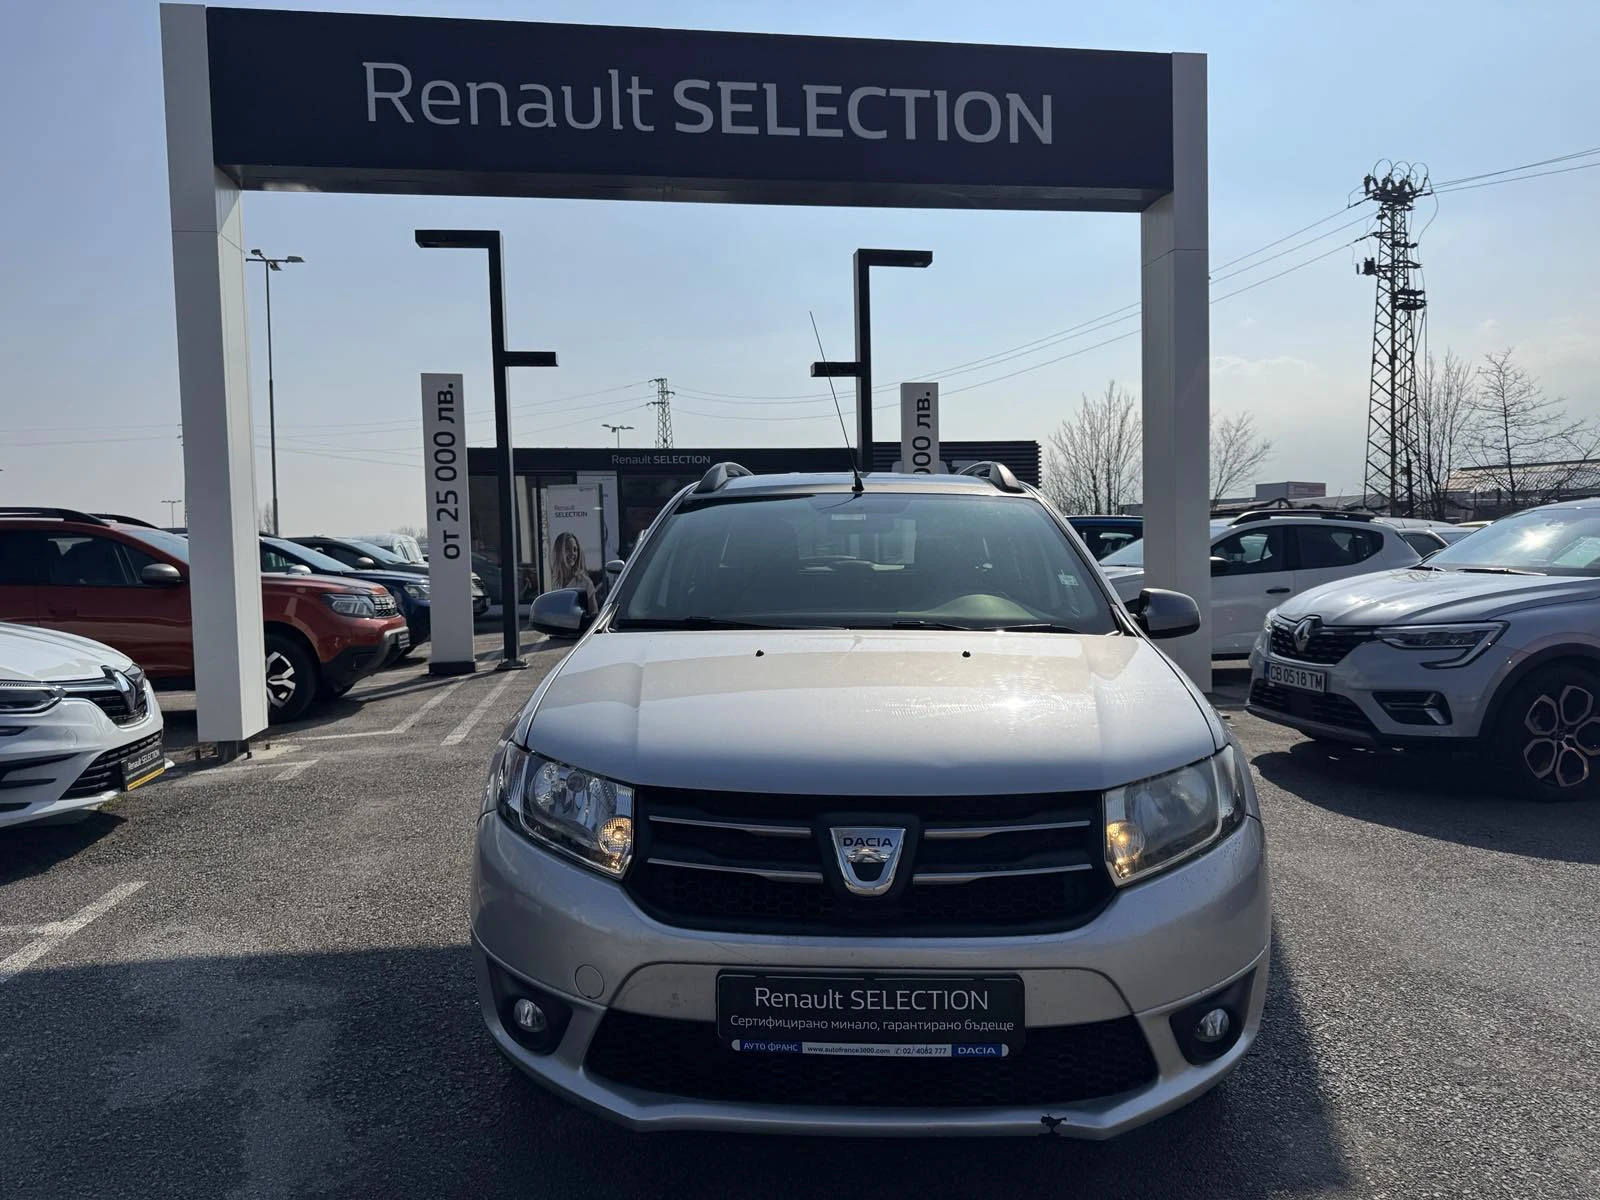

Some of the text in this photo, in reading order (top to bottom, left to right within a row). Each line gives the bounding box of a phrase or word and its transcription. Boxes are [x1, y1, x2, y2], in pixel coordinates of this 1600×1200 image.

[362, 61, 1053, 145] Renault SELECTION
[916, 391, 931, 429] лв.
[611, 454, 711, 465] Renault SELECTION
[433, 383, 461, 560] от 25 000 лв.
[843, 837, 893, 848] DACIA
[754, 986, 989, 1010] Renault SELECTION
[730, 1015, 1014, 1032] Сертифицирано минало, гарантирано бъдеще
[743, 1042, 799, 1052] АУТО ФРАНС
[957, 1046, 996, 1055] DACIA
